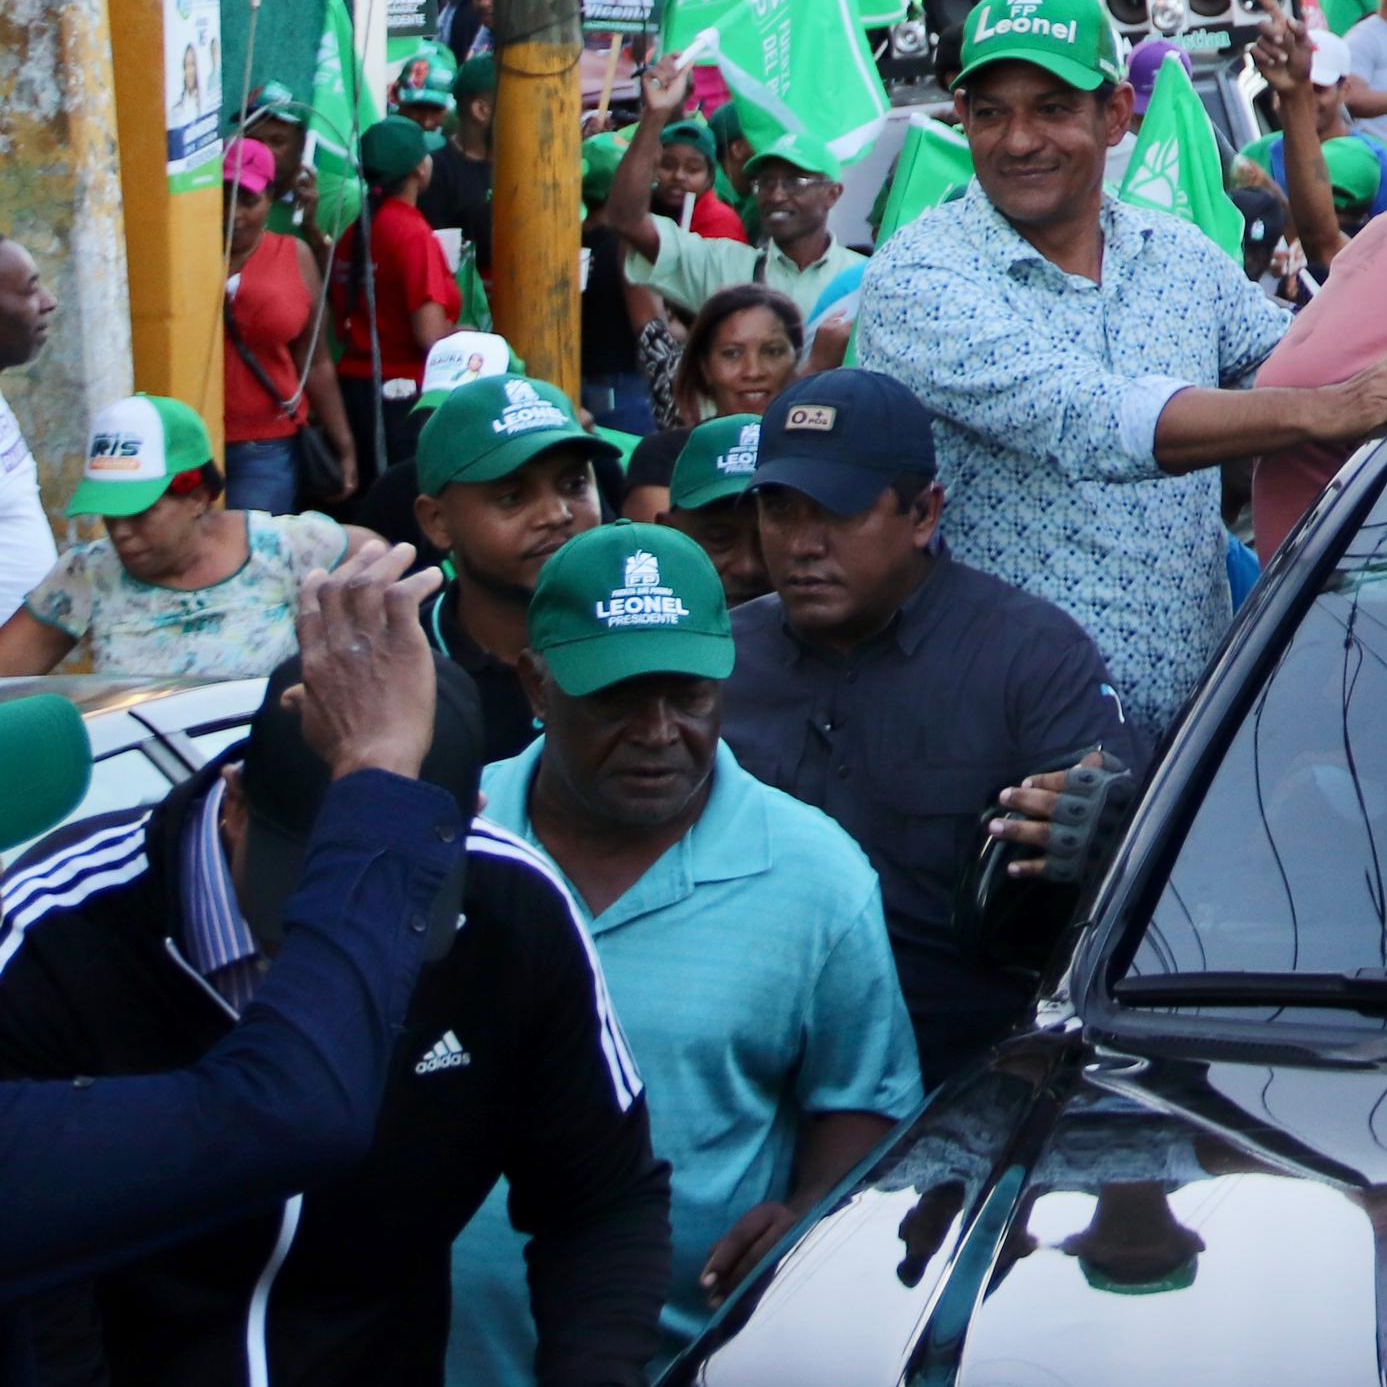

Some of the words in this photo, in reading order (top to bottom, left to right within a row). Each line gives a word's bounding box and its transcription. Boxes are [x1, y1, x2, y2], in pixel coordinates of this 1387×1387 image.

[1010, 4, 1038, 17] FP
[973, 5, 1078, 45] Leonel
[596, 596, 690, 619] LEONEL
[608, 613, 679, 628] PRESIDENTE
[415, 1053, 471, 1074] adidas
